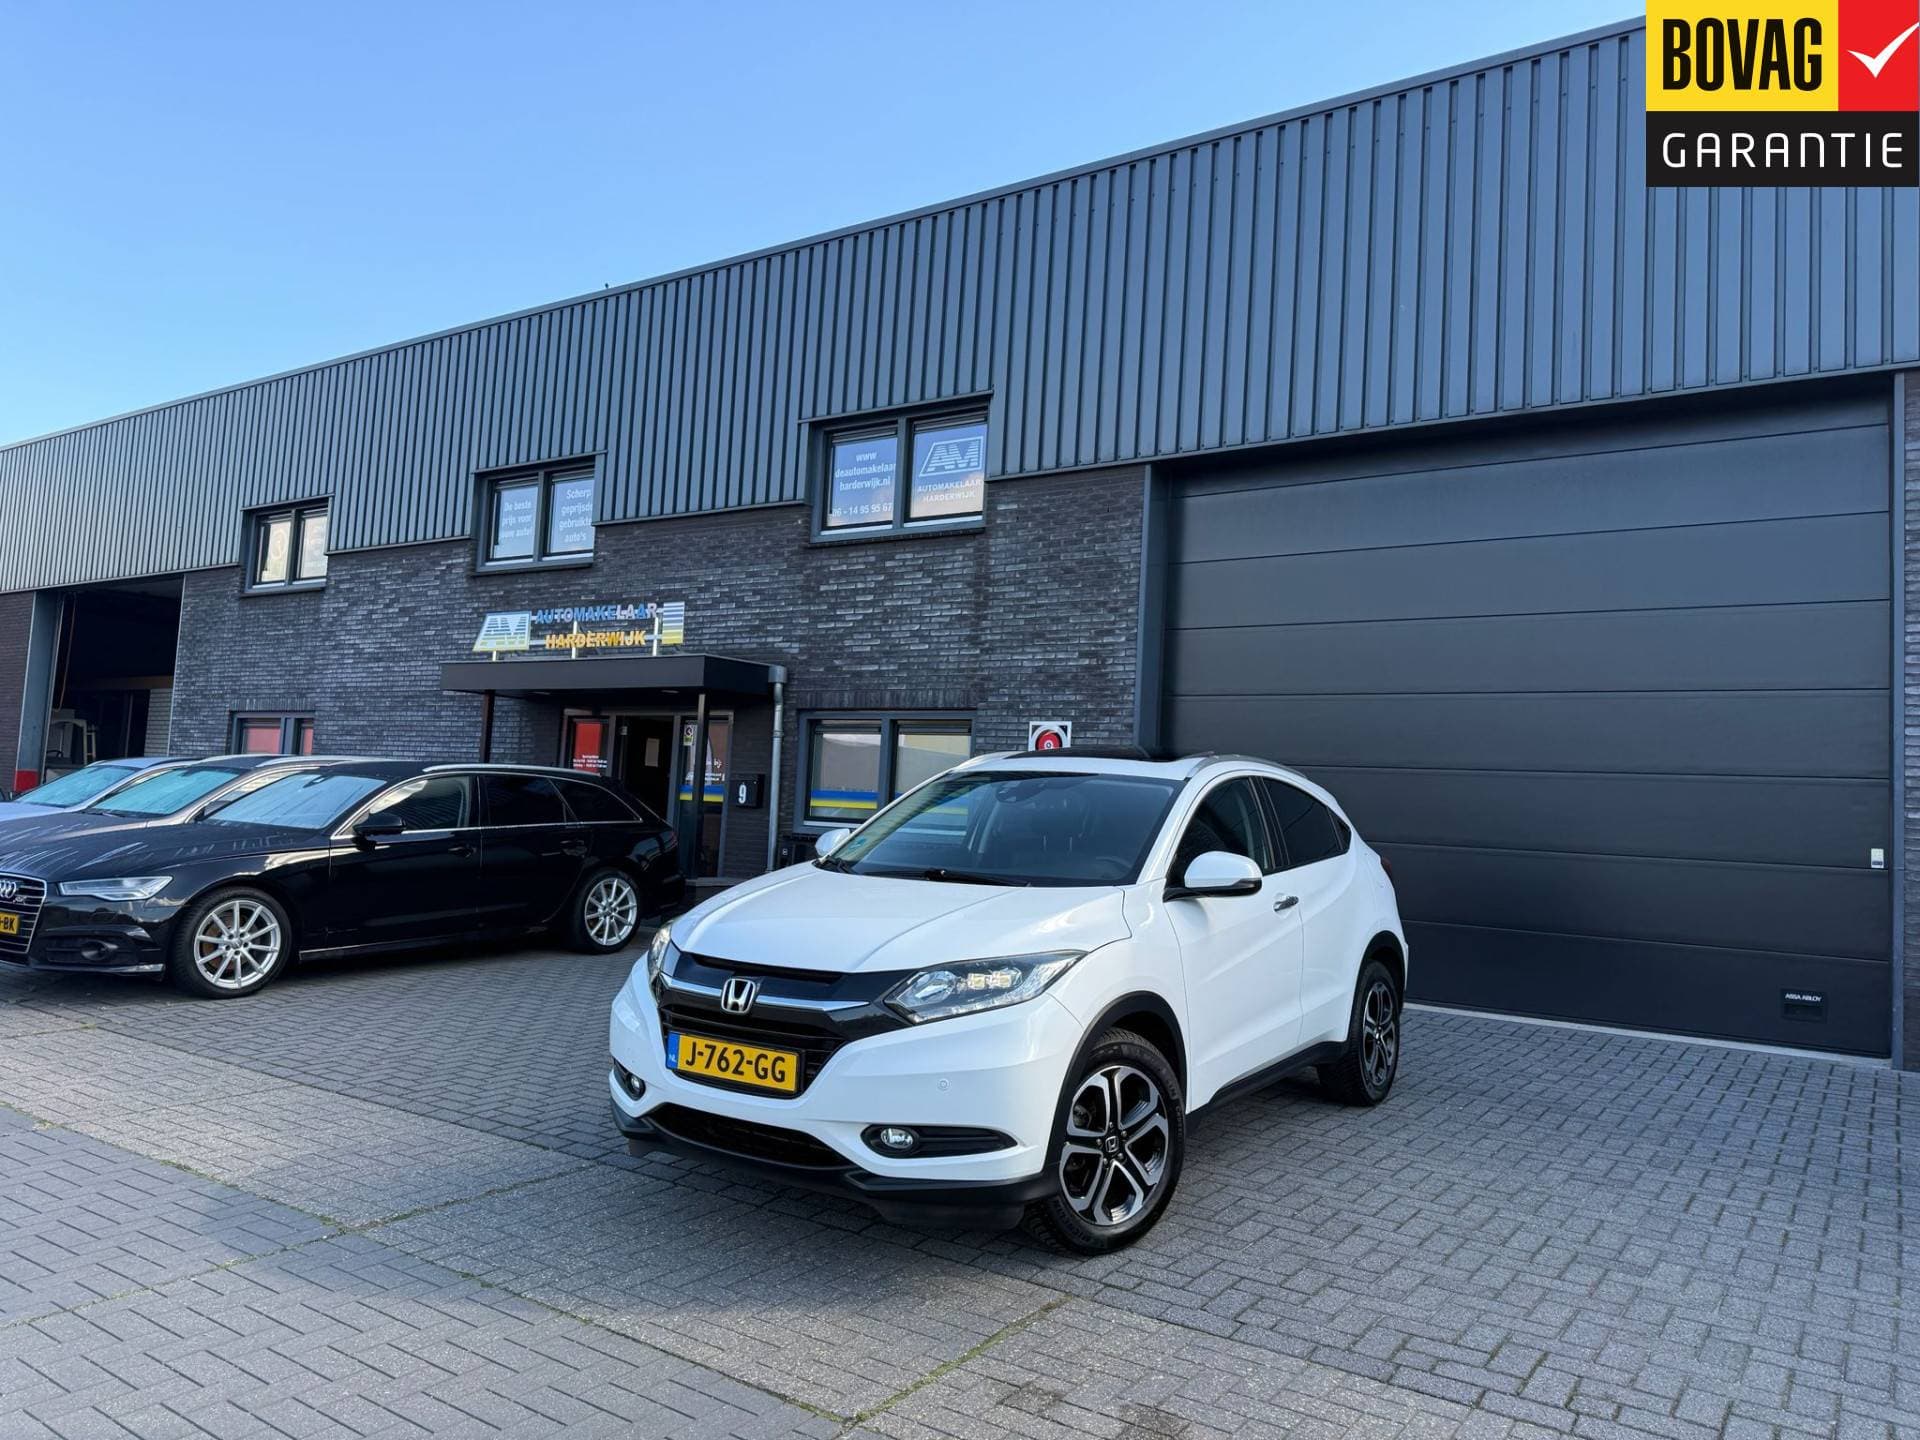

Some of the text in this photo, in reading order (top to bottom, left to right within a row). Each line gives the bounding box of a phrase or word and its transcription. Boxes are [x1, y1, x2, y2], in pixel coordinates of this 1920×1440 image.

[855, 452, 877, 462] www
[835, 463, 896, 478] deautomakelaar
[839, 476, 891, 491] harderwijk.nl
[918, 479, 982, 492] AUTOMAKELAAR
[923, 490, 975, 503] HARDERWIJK
[849, 505, 858, 515] 14
[535, 603, 658, 624] AUTOMAKELAAR
[545, 630, 647, 649] HARDERWIJK
[738, 784, 747, 804] 9
[1785, 993, 1822, 1002] ASSA ABLOY
[668, 1053, 678, 1063] NL
[685, 1041, 786, 1083] J-762-GG
